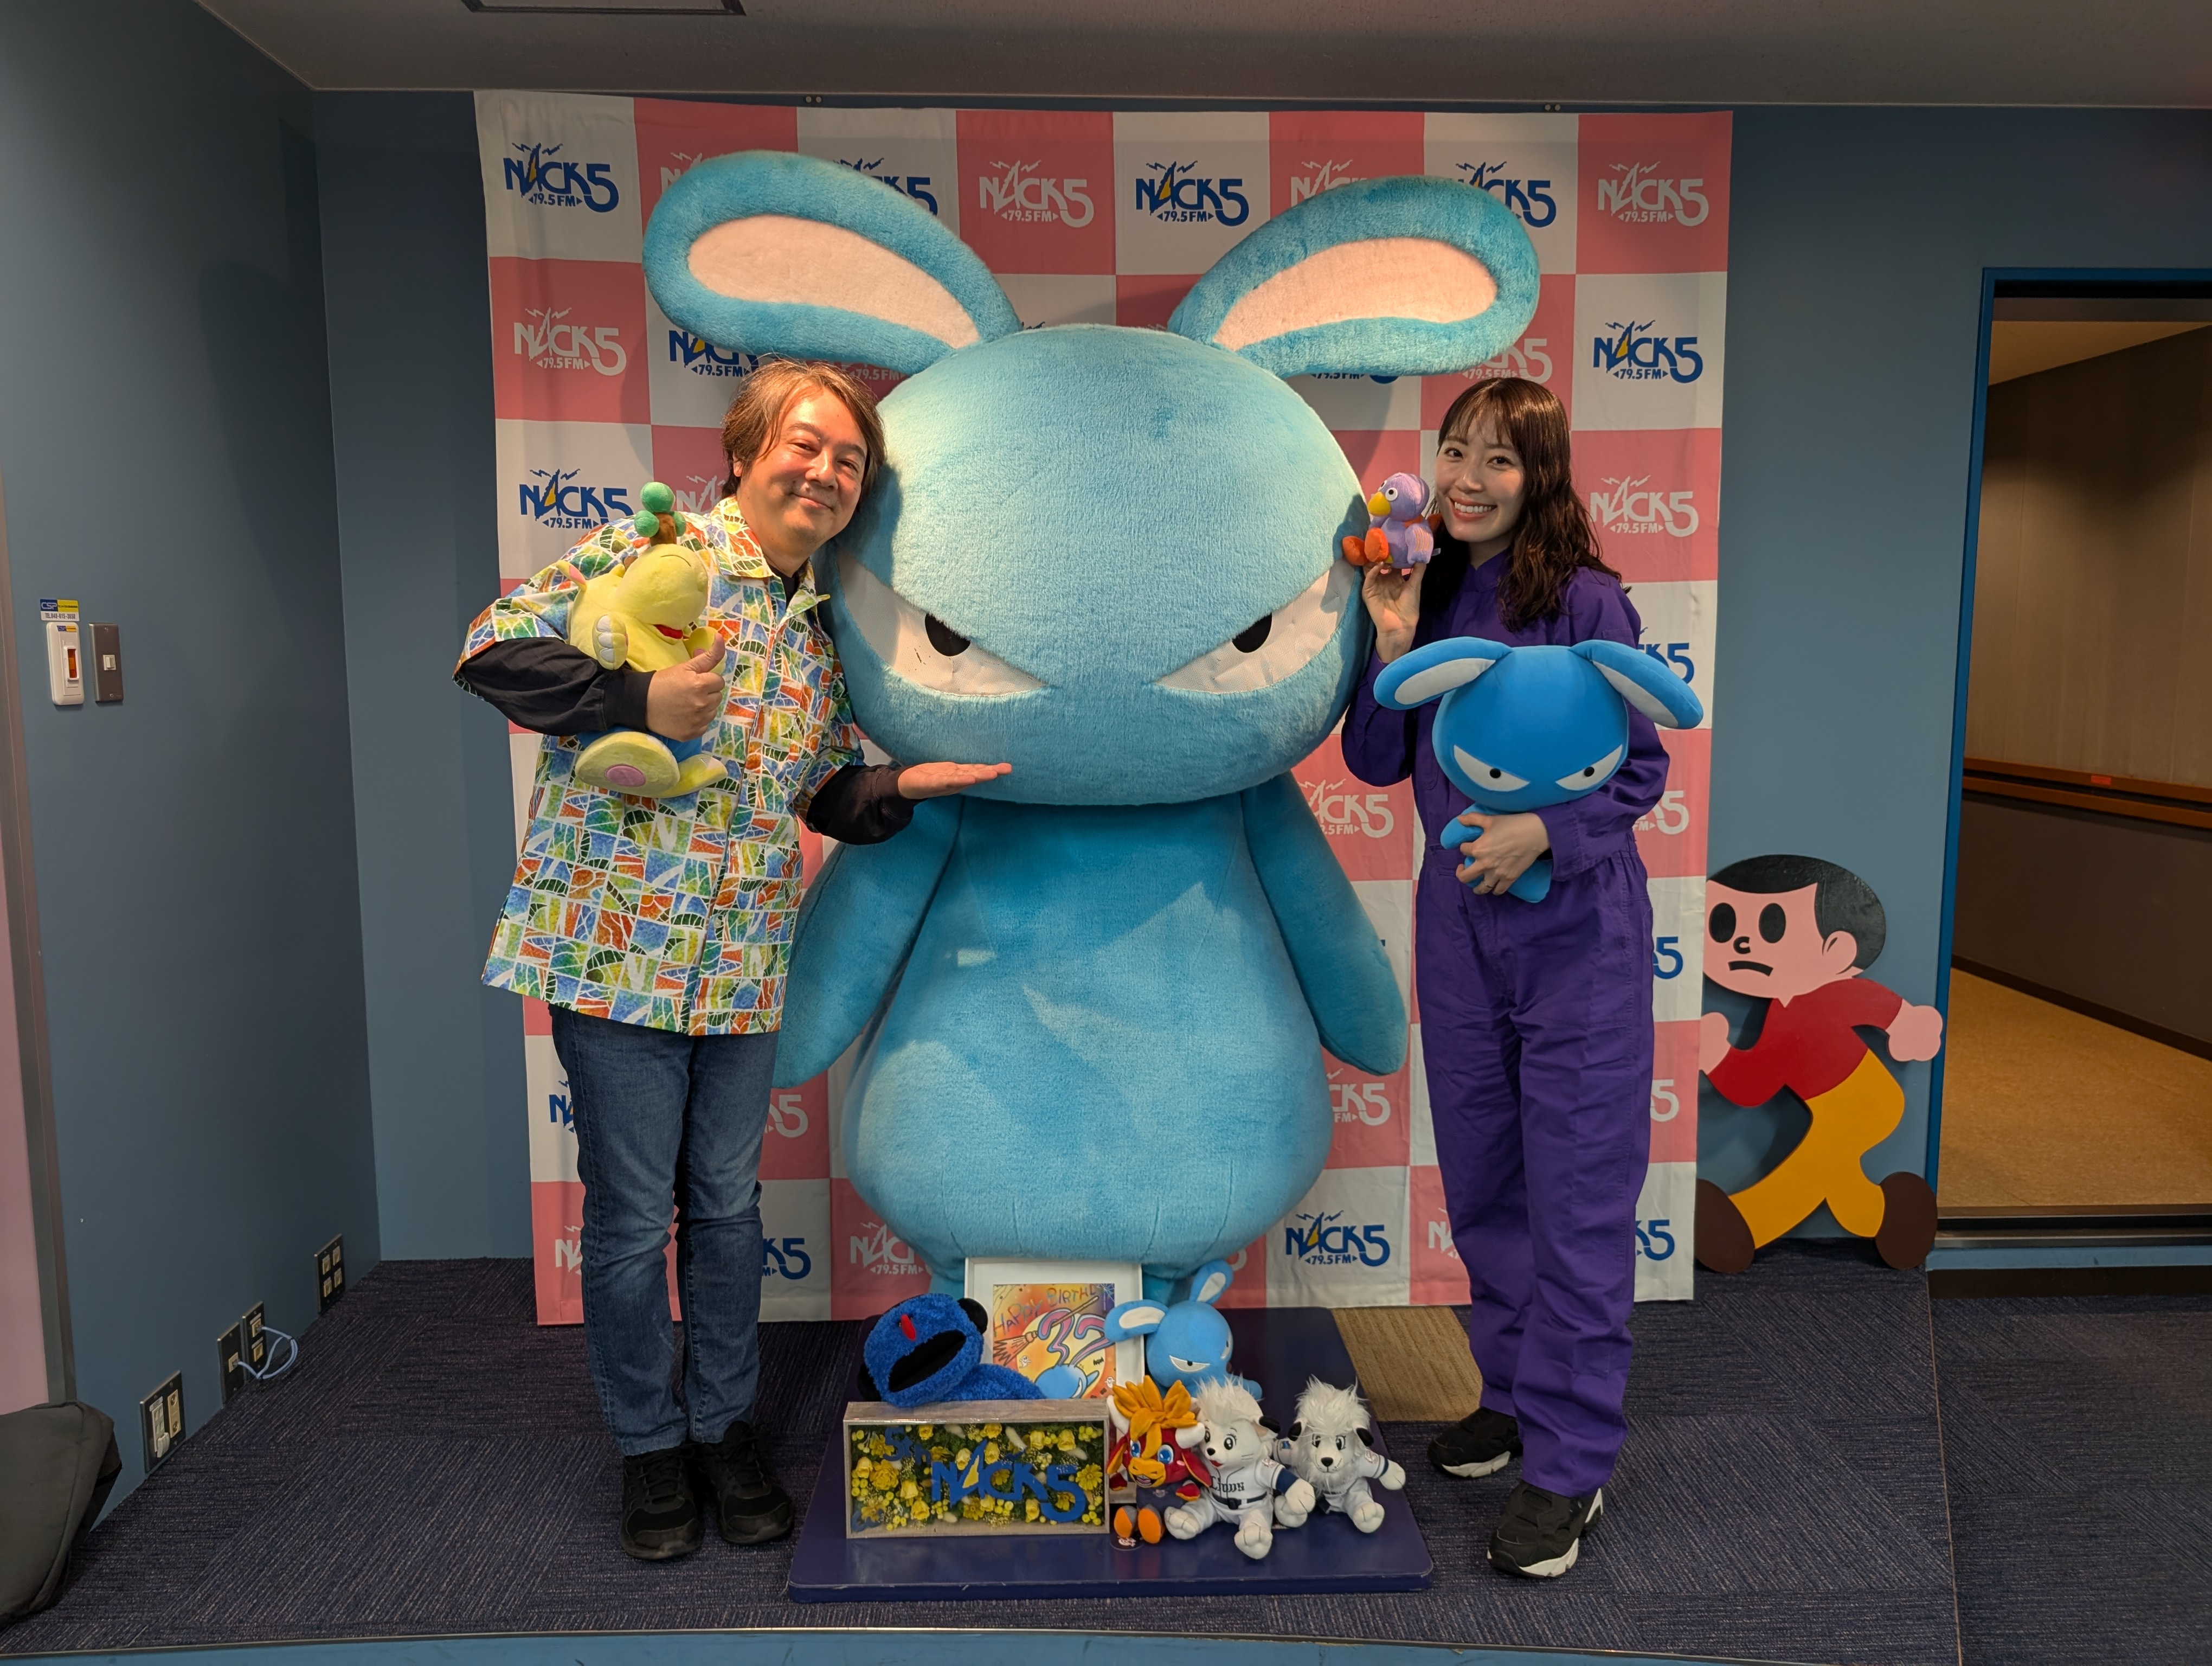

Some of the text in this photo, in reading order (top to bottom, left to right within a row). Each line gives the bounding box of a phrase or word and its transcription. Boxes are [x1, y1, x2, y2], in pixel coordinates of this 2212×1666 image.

[503, 143, 619, 213] NACK5
[979, 161, 1094, 228] NACK5
[1135, 162, 1250, 227] NACK5
[1598, 162, 1709, 227] NACK5
[514, 307, 627, 376] NACK5
[1593, 321, 1703, 383] NACK5
[1590, 476, 1699, 537] NACK5
[1286, 1212, 1390, 1266] NACK5
[931, 1439, 1086, 1523] NACK5
